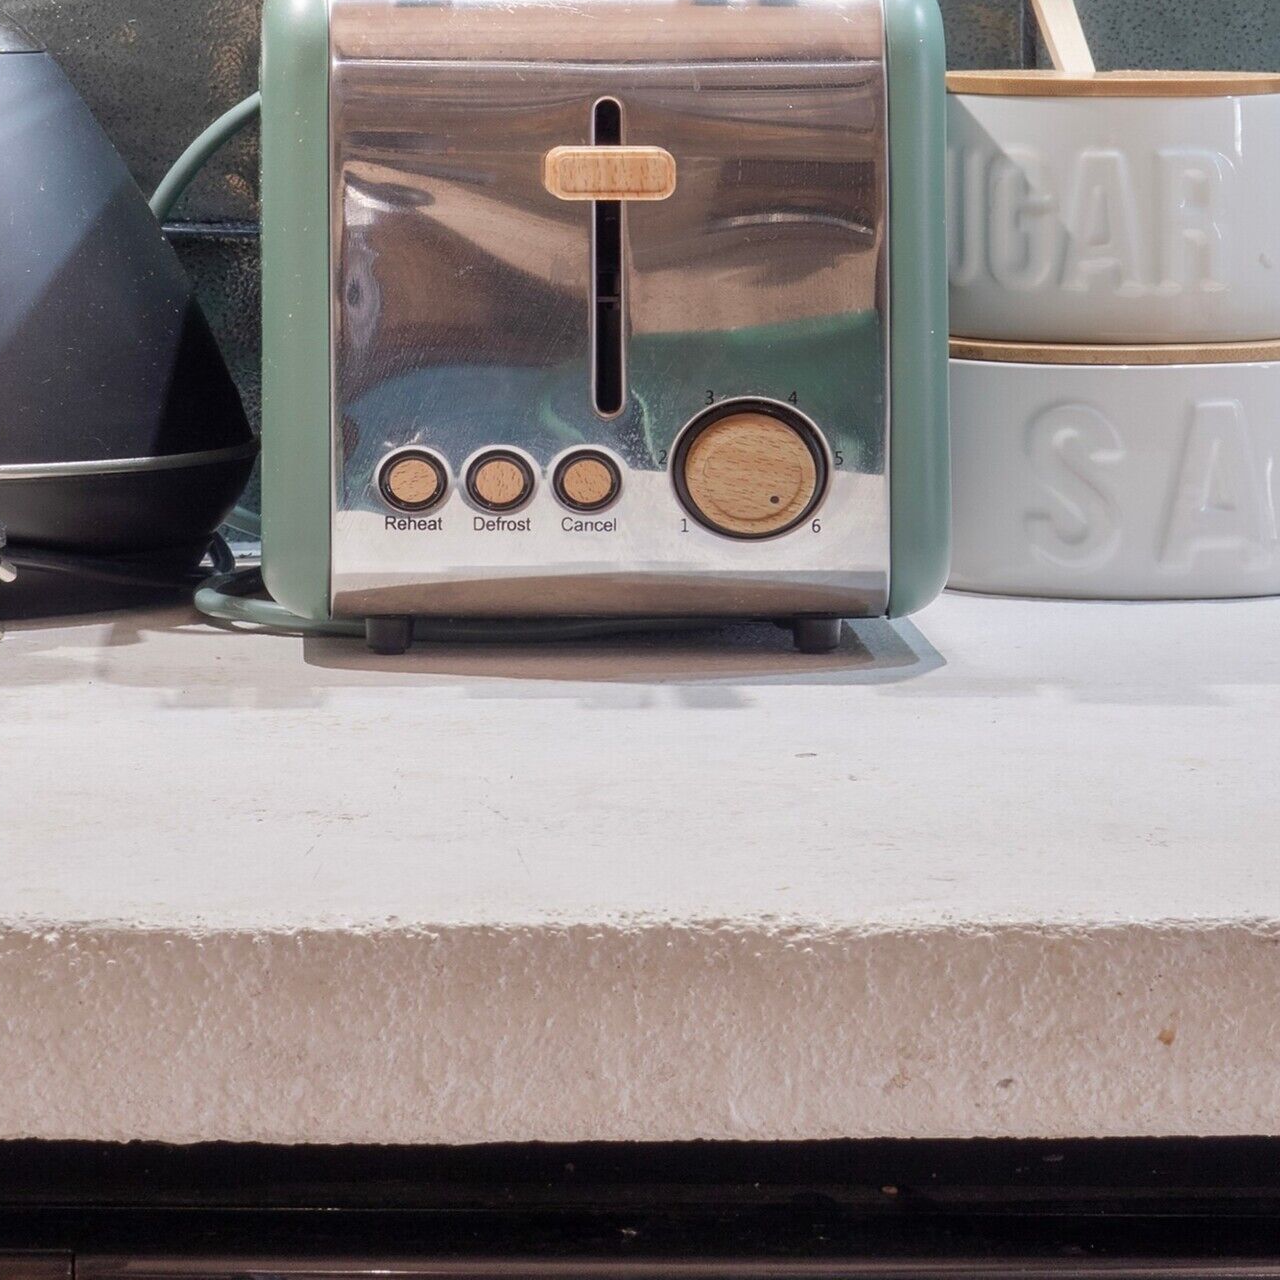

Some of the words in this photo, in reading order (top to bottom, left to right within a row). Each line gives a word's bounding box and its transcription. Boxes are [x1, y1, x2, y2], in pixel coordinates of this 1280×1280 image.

[705, 390, 715, 406] 3
[788, 391, 798, 405] 4
[658, 450, 668, 465] 2
[834, 451, 844, 465] 5
[384, 516, 443, 531] Reheat
[473, 516, 531, 532] Defrost
[560, 517, 617, 532] Cancel
[680, 518, 689, 533] 1
[811, 518, 821, 533] 6
